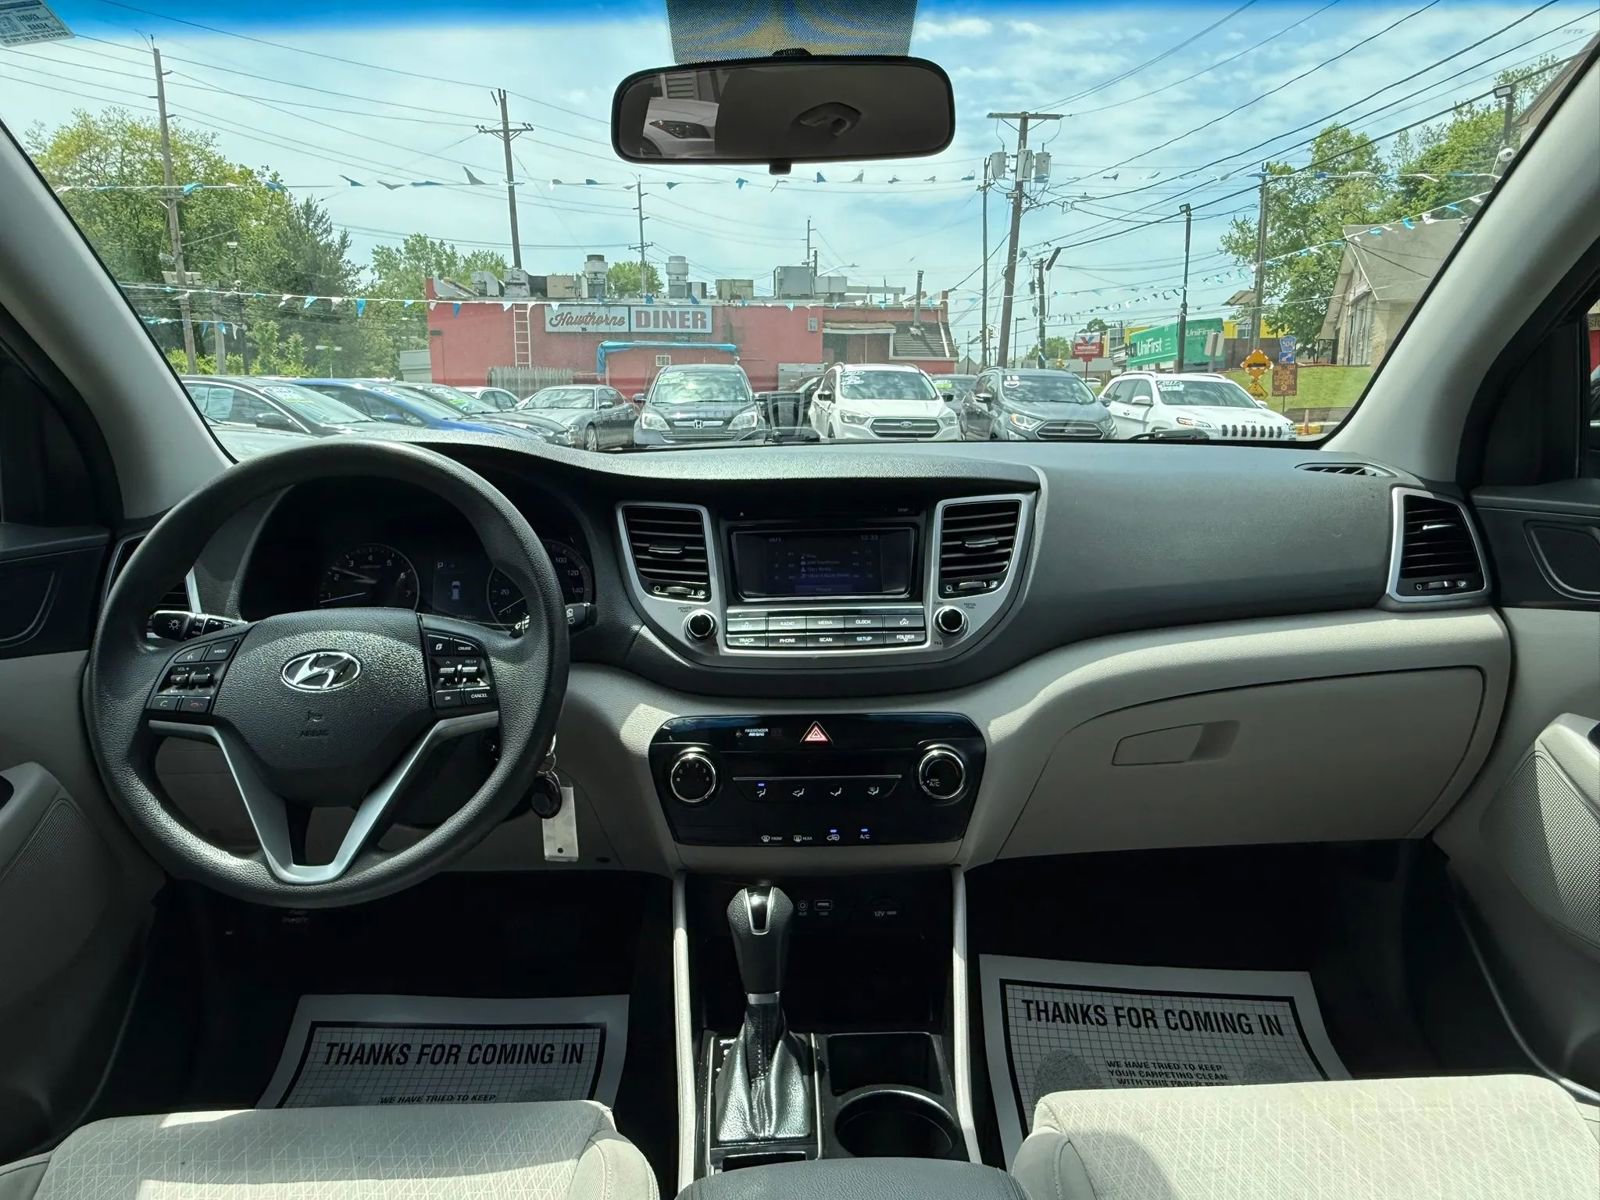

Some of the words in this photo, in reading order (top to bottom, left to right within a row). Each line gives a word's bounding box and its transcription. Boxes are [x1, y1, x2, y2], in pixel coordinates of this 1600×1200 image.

[549, 310, 626, 327] Hawthorne
[635, 310, 707, 329] DINER
[1137, 338, 1162, 356] UniFirst
[1021, 1000, 1108, 1027] THANKS
[1114, 1006, 1159, 1030] FOR
[1164, 1008, 1254, 1035] COMING
[1257, 1014, 1285, 1037] IN
[324, 1042, 411, 1065] THANKS
[416, 1043, 460, 1065] FOR
[467, 1042, 555, 1065] COMING
[561, 1043, 584, 1065] IN
[1107, 1060, 1122, 1068] WE
[1124, 1061, 1150, 1069] HAVE
[1152, 1062, 1180, 1070] TRIED
[1183, 1063, 1196, 1071] TO
[1109, 1069, 1136, 1077] YOUR
[1138, 1071, 1193, 1079] CARPETING
[1195, 1072, 1228, 1080] CLEAN
[1116, 1078, 1143, 1086] WITH
[379, 1095, 396, 1104] WE
[397, 1095, 424, 1103] HAVE
[426, 1094, 454, 1102] TRIED
